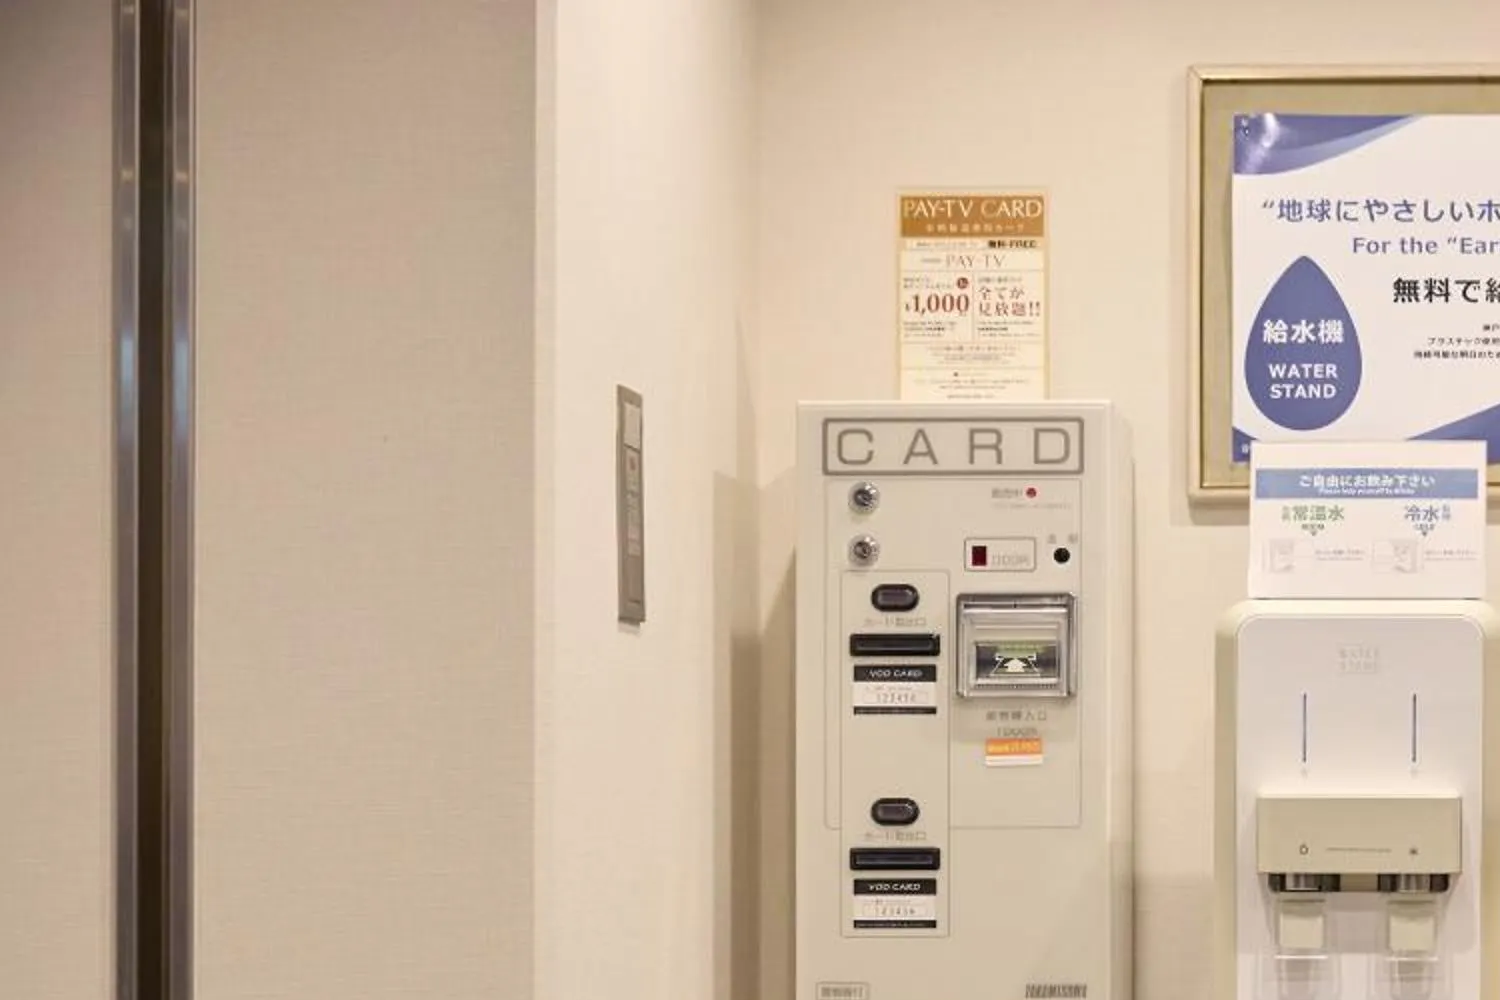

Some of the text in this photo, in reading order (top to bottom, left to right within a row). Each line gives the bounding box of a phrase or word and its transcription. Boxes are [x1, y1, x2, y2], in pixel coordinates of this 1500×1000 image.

[903, 199, 1042, 218] PAY-TV CARD
[1352, 237, 1391, 254] For
[1399, 236, 1438, 254] the
[1263, 319, 1345, 344] 給水機
[1268, 363, 1339, 379] WATER
[1269, 383, 1337, 400] STAND
[836, 428, 1071, 465] CARD
[1404, 504, 1440, 522] 冷水
[892, 883, 921, 892] CARD
